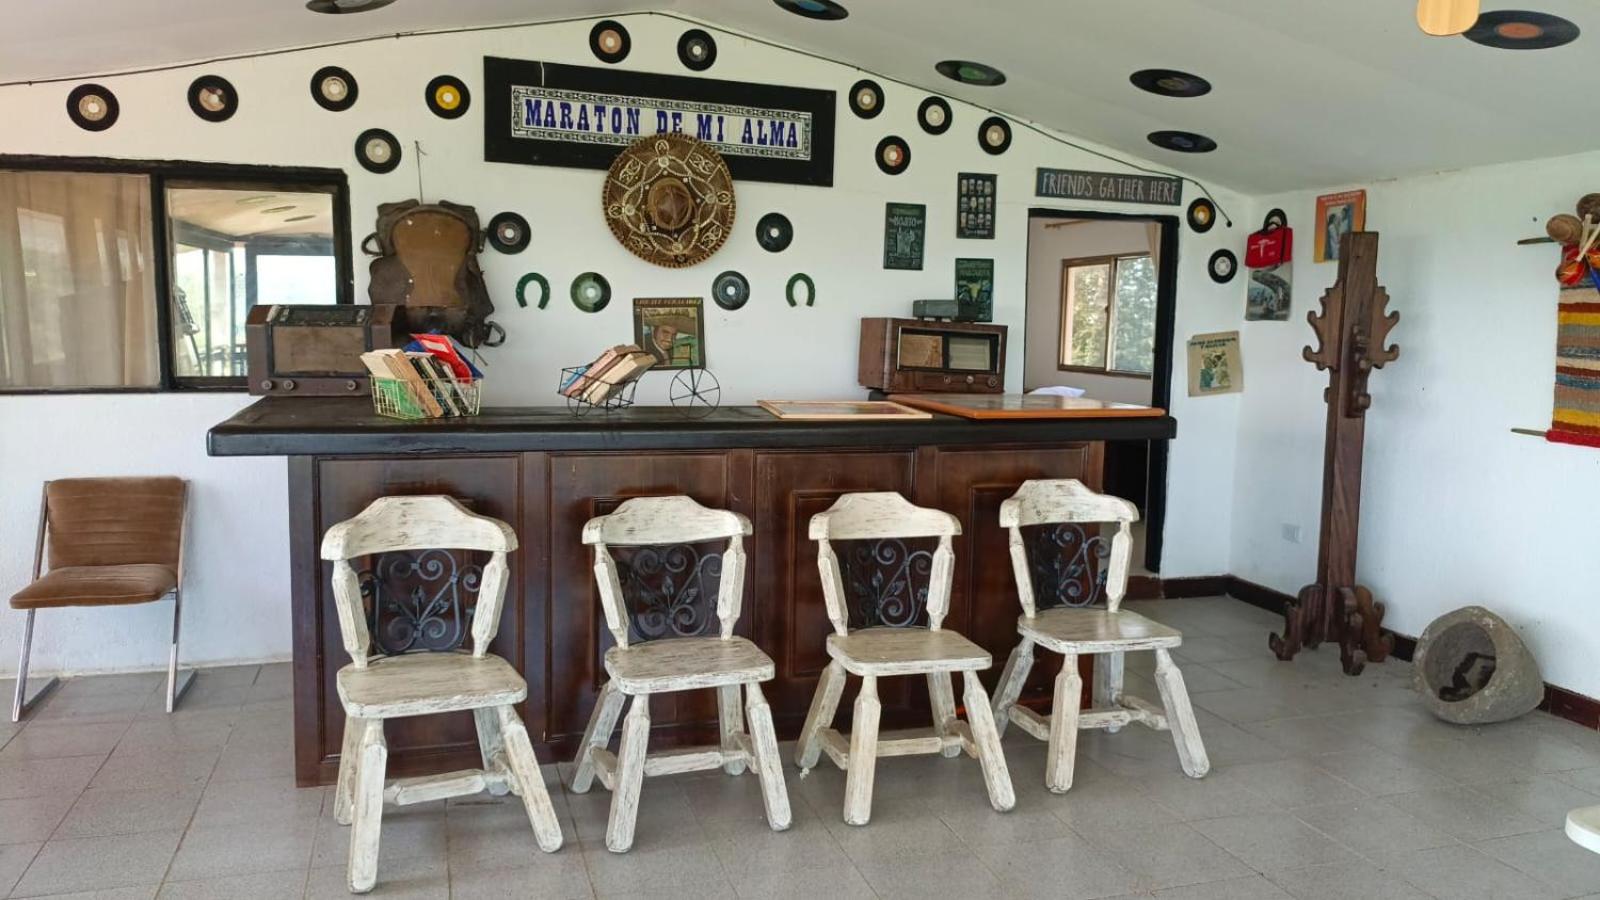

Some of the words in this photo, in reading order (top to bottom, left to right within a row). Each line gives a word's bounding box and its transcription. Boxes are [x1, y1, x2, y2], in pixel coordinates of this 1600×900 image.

[525, 98, 640, 135] MARATON
[656, 110, 683, 134] DE
[696, 113, 724, 142] MI
[741, 118, 798, 148] ALMA
[1042, 172, 1093, 197] FRIENDS
[1099, 177, 1145, 201] GATHER
[1150, 180, 1178, 203] HERE
